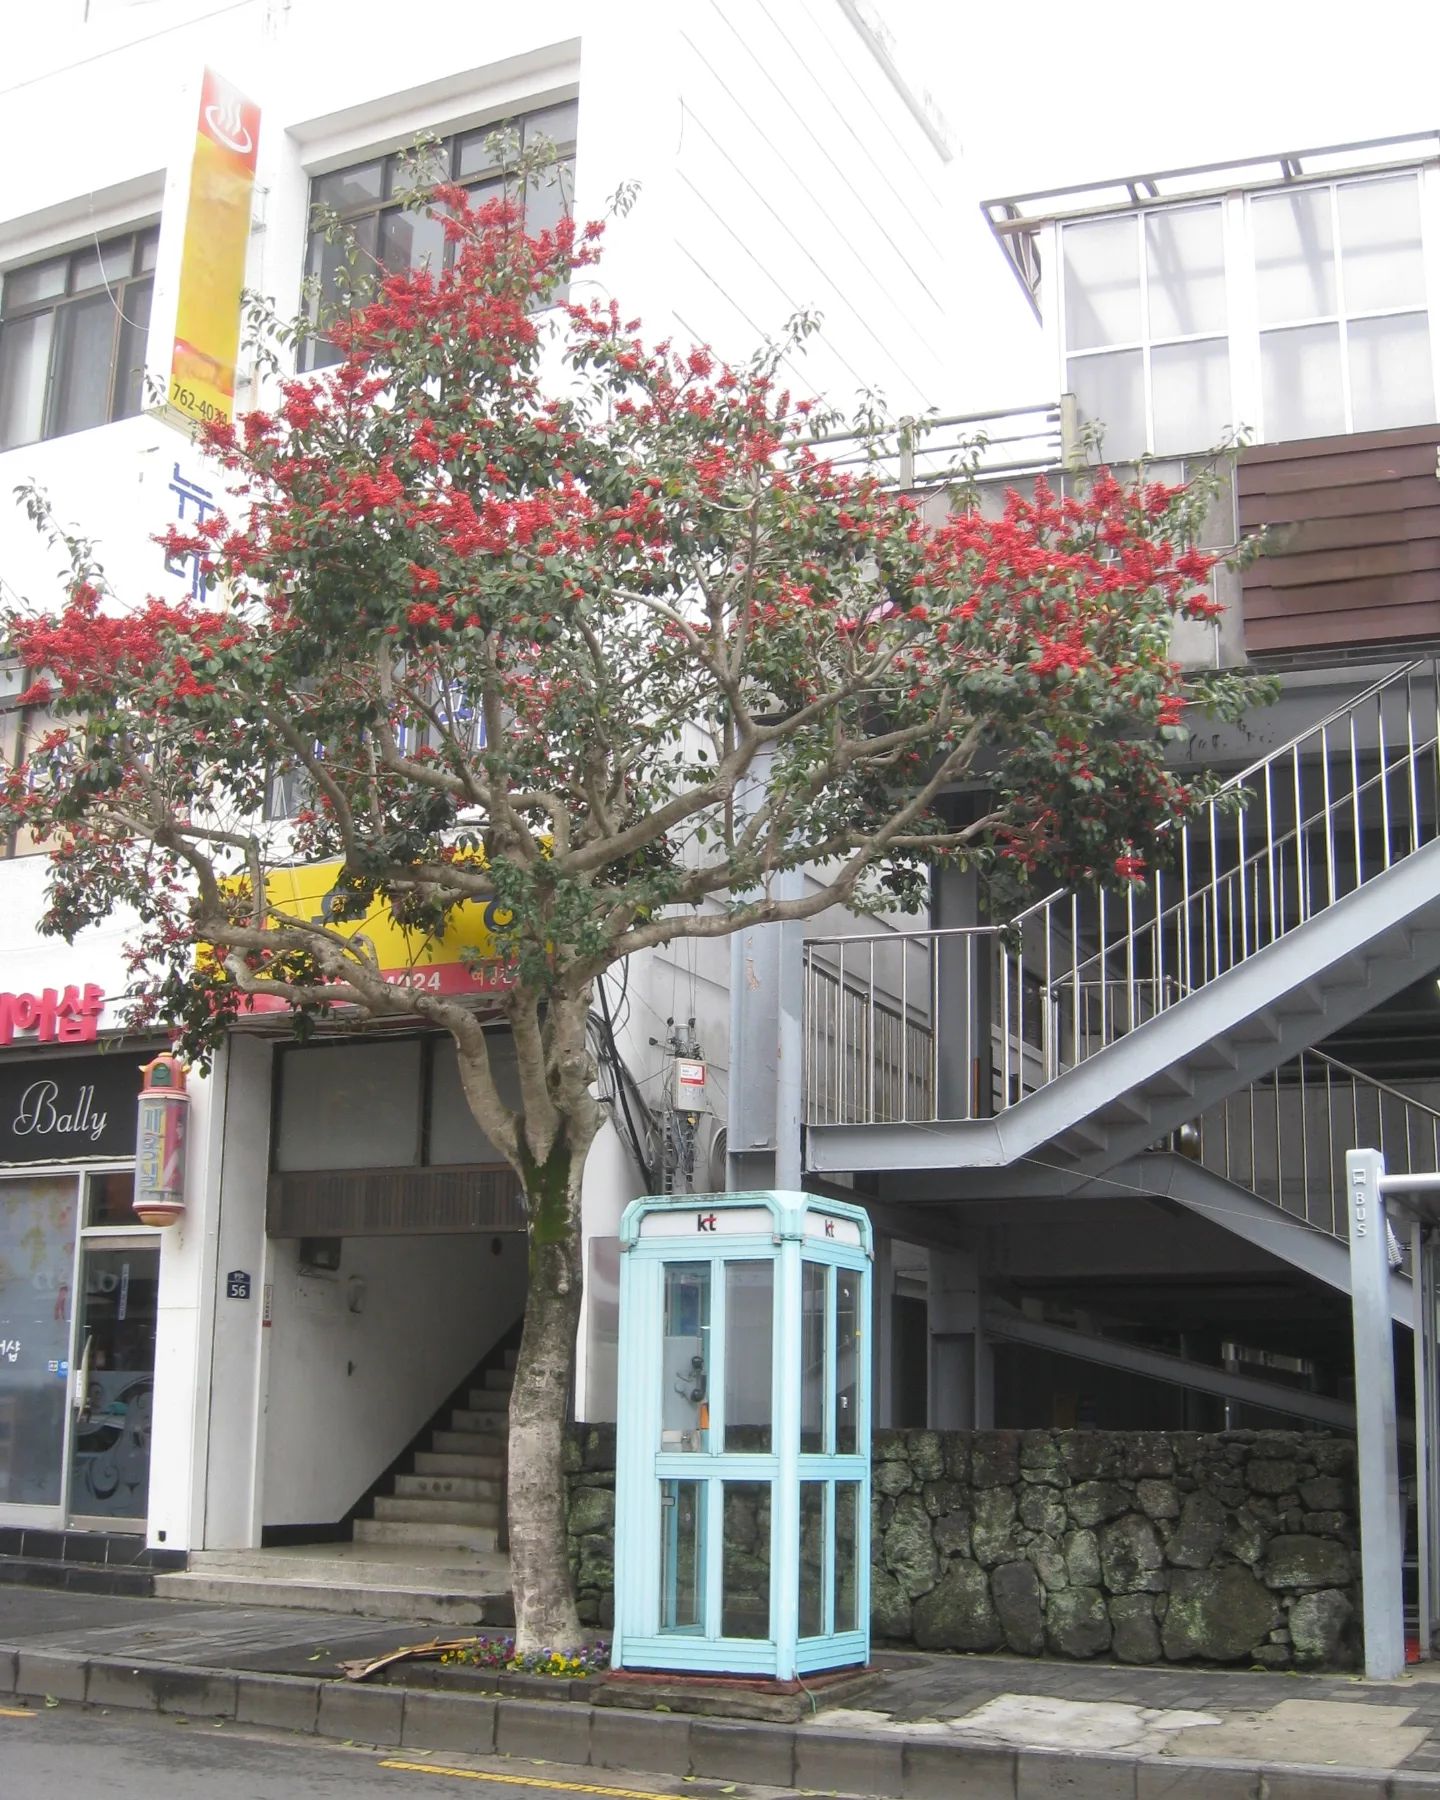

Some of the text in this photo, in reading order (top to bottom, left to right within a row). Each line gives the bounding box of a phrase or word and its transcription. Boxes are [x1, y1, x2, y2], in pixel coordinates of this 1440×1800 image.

[12, 1080, 108, 1141] Bally
[697, 1213, 717, 1232] kt
[1355, 1191, 1368, 1238] BUS
[824, 1219, 835, 1238] kt
[231, 1284, 247, 1297] 56
